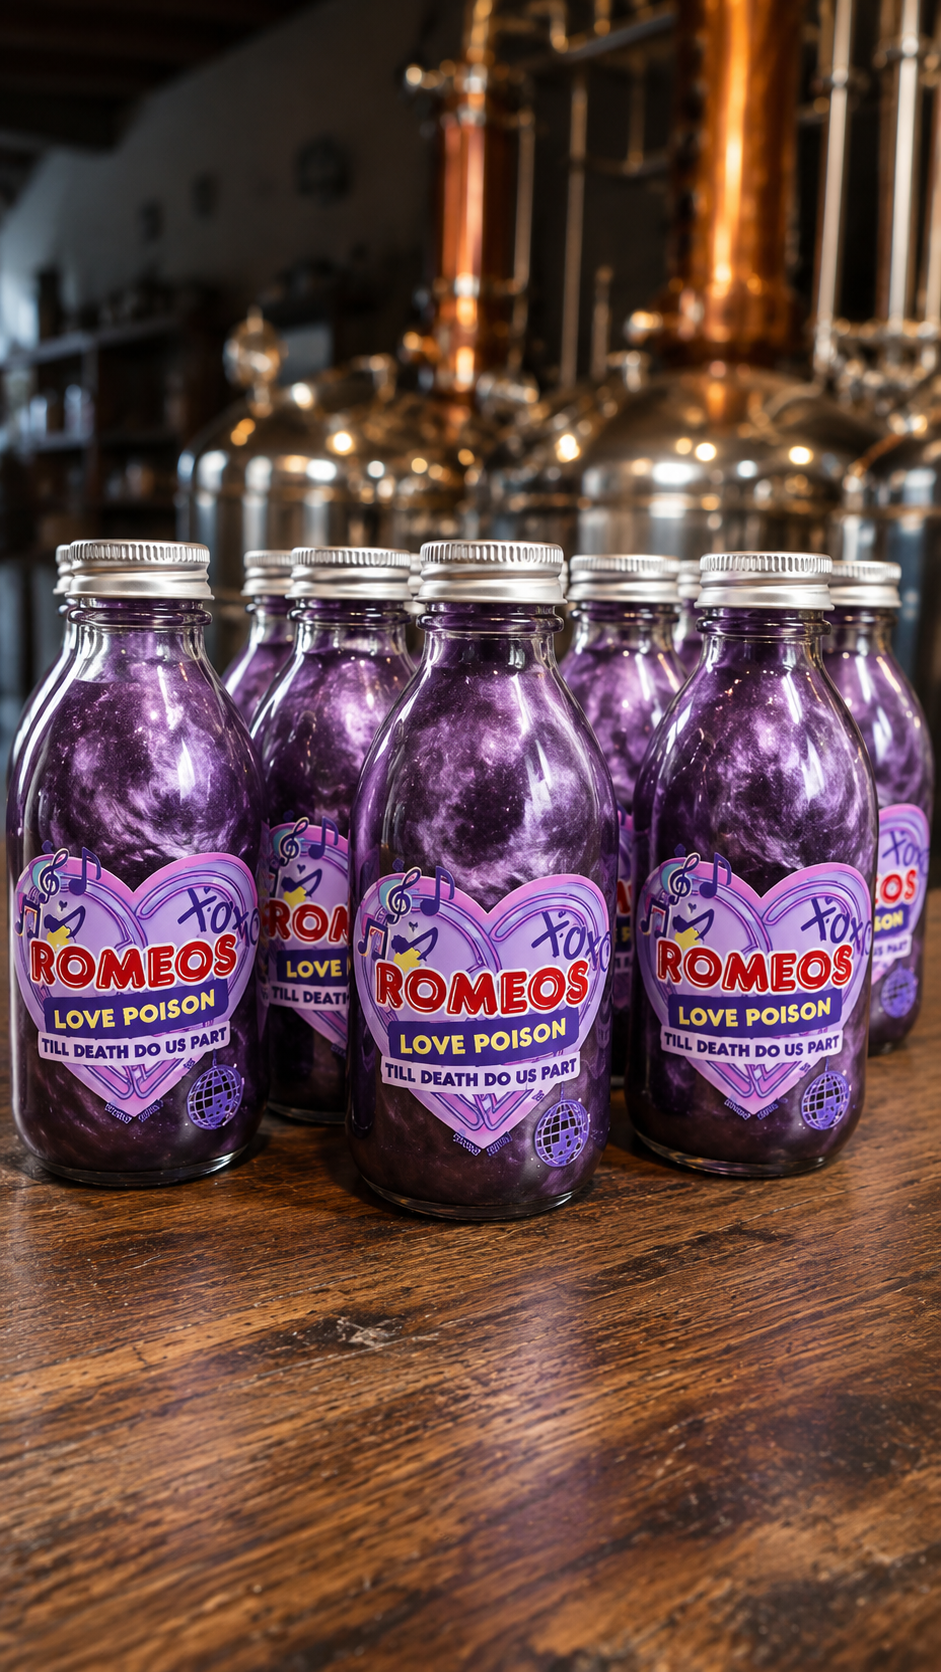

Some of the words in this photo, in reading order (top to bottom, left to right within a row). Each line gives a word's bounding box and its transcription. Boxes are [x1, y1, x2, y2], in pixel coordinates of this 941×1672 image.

[30, 933, 237, 990] ROMEOS
[286, 960, 342, 978] LOVE
[657, 940, 853, 993] ROMEOS
[272, 986, 299, 1002] TILL
[375, 960, 589, 1016] ROMEOS
[54, 1009, 116, 1029] LOVE
[123, 989, 215, 1026] POISON
[678, 1006, 738, 1027] LOVE
[746, 997, 831, 1026] POISON
[42, 1038, 69, 1056] TILL
[74, 1044, 129, 1059] DEATH
[134, 1042, 161, 1058] DO
[165, 1035, 186, 1053] US
[190, 1027, 227, 1048] PART
[400, 1034, 466, 1055] LOVE
[474, 1018, 566, 1053] POISON
[664, 1032, 693, 1051] TILL
[697, 1039, 750, 1057] DEATH
[755, 1044, 780, 1058] DO
[784, 1041, 804, 1056] US
[808, 1035, 840, 1054] PART
[385, 1062, 416, 1082] TILL
[420, 1070, 478, 1087] DEATH
[484, 1071, 511, 1087] DO
[516, 1068, 537, 1084] US
[541, 1058, 577, 1081] PART
